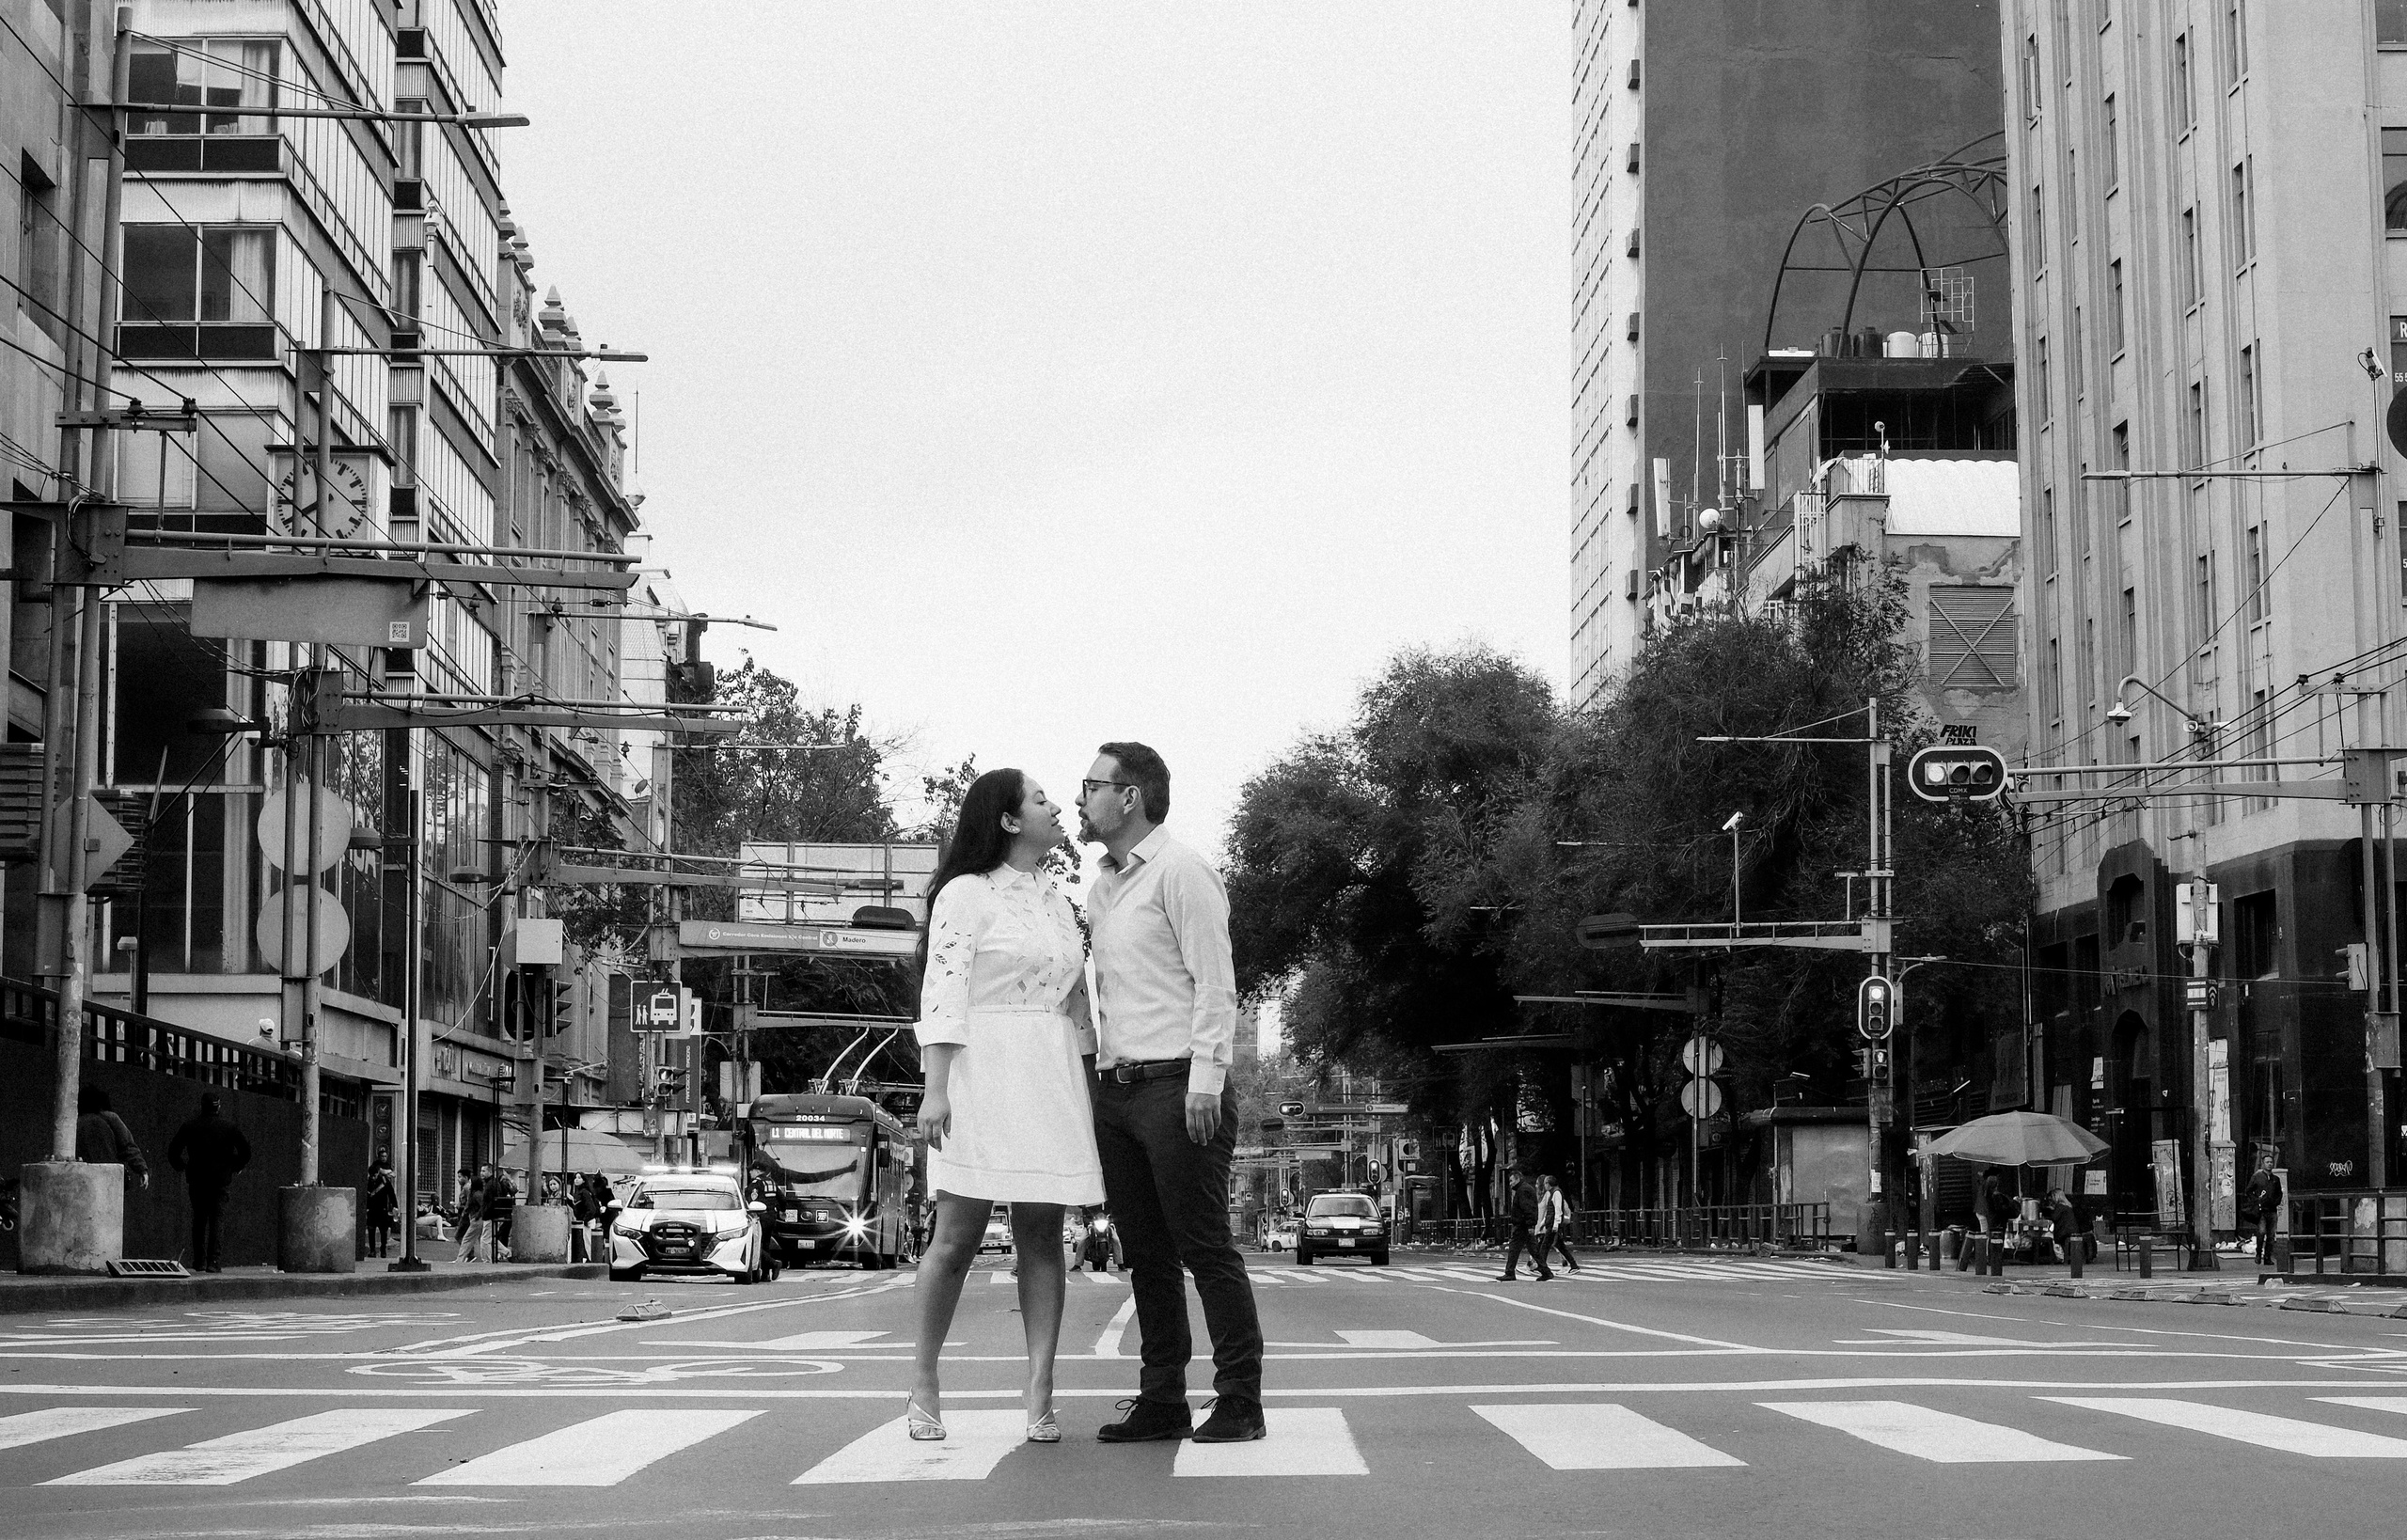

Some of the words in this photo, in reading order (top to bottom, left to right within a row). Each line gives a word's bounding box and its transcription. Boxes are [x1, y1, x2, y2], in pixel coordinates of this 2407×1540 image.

[2394, 372, 2403, 383] 55
[1940, 724, 1977, 738] FRIKI
[1945, 737, 1977, 746] PLAZA
[772, 1127, 779, 1139] L1
[784, 1127, 810, 1139] CENTRAL
[811, 1128, 824, 1139] DEL
[824, 1128, 844, 1139] NORTE
